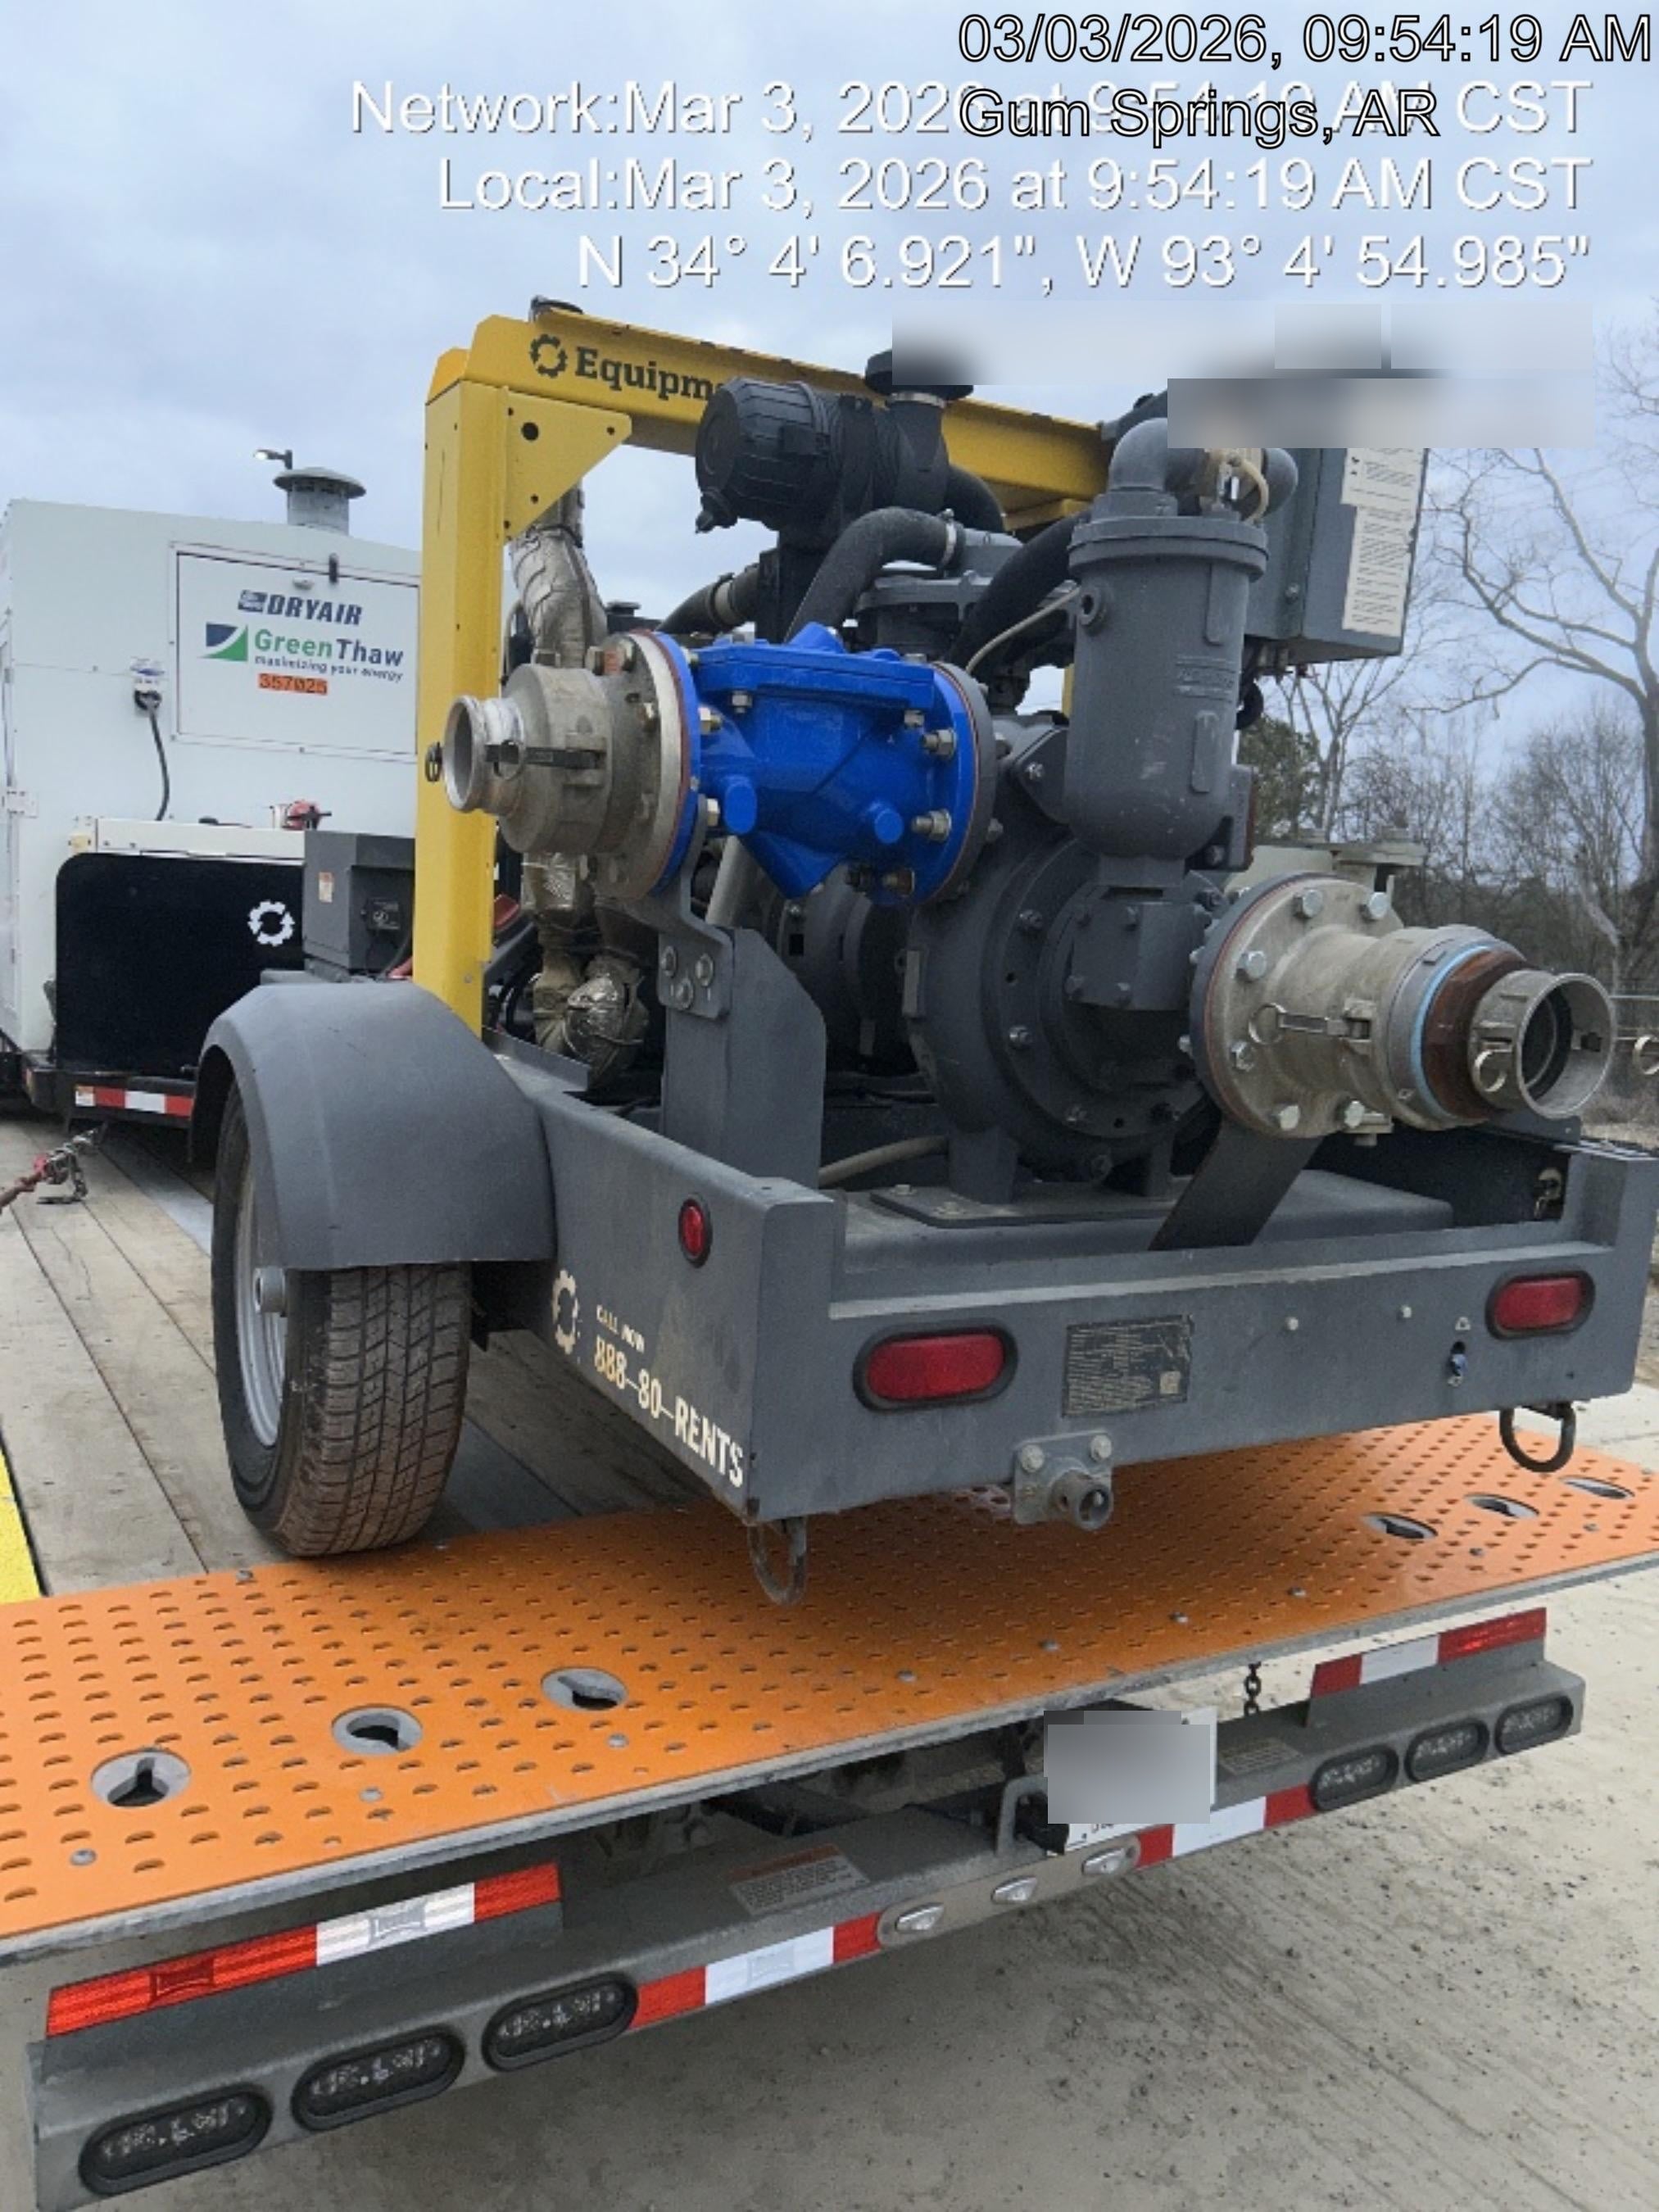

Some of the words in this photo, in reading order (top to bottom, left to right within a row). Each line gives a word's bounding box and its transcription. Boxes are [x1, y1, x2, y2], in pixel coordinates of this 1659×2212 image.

[574, 345, 722, 402] Equipm
[267, 594, 363, 625] DRYAIR
[594, 1334, 744, 1488] 888-80-RENTS
